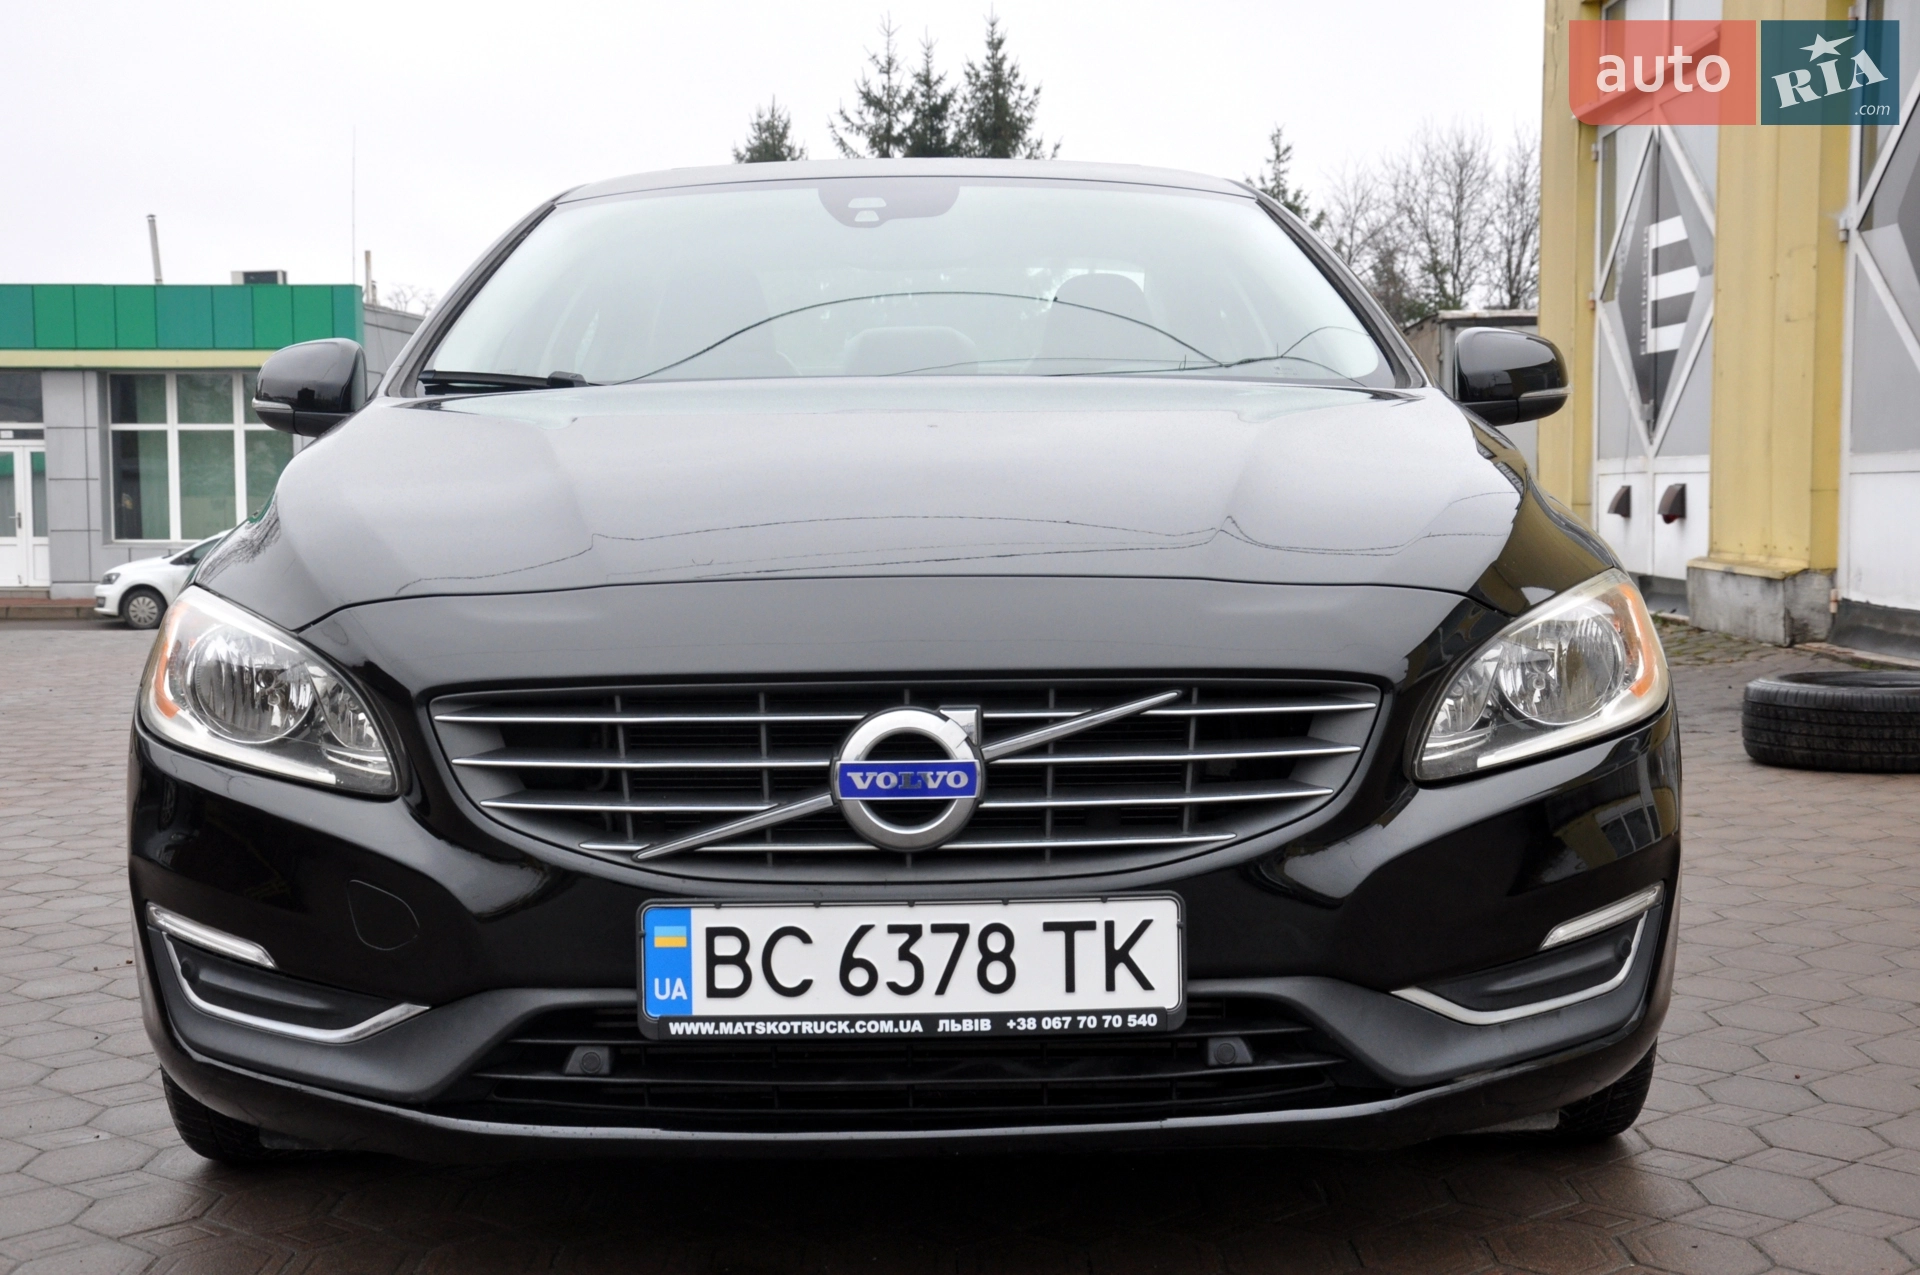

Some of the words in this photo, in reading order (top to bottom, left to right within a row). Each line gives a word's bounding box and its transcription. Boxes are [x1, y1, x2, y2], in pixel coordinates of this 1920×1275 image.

[847, 770, 968, 790] VOLVO
[706, 925, 814, 999] BC
[840, 923, 1017, 997] 6378
[1043, 919, 1155, 994] TK
[654, 978, 688, 1001] UA
[668, 1020, 923, 1035] WWW.MATSKOTRUCK.COM.UA
[937, 1018, 992, 1033] ЛЬВІВ
[1006, 1017, 1038, 1031] +38
[1040, 1016, 1072, 1030] 067
[1077, 1015, 1097, 1029] 70
[1102, 1014, 1122, 1028] 70
[1127, 1013, 1158, 1028] 540
